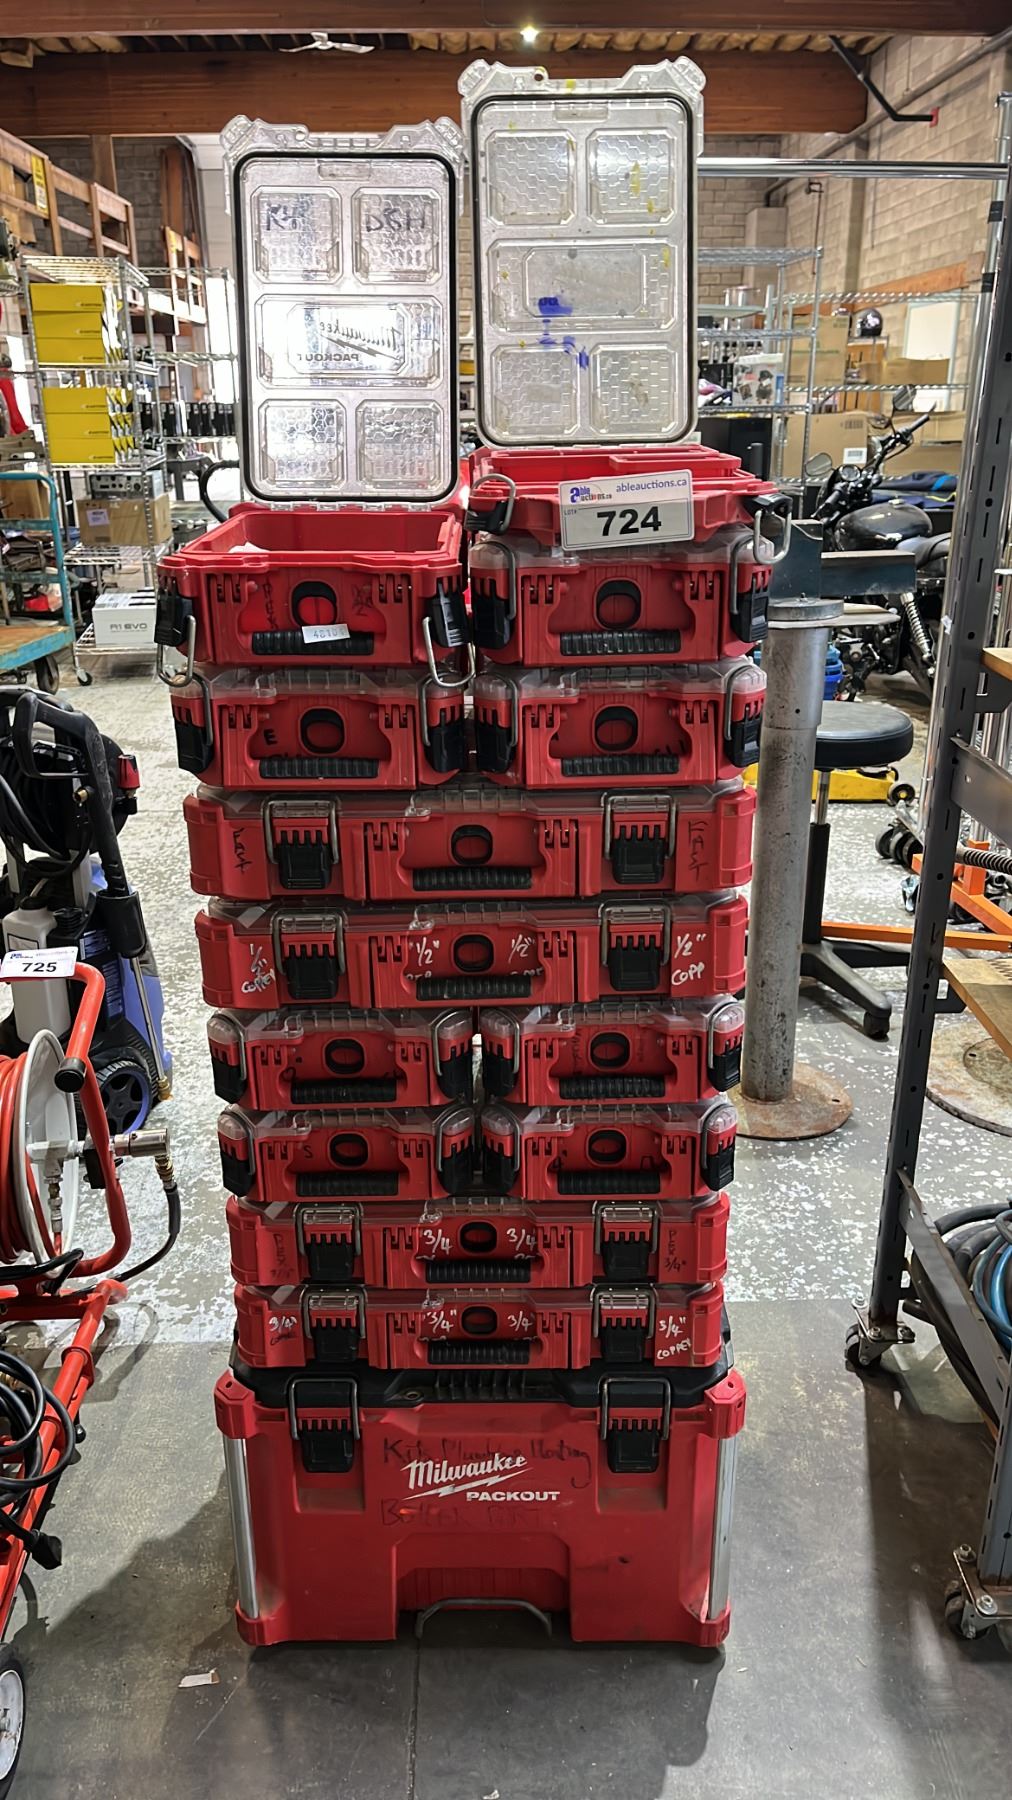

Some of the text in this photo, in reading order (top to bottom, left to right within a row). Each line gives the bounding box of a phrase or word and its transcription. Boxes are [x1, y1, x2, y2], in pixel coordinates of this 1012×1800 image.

[616, 479, 687, 493] ableauctions.ca
[597, 506, 661, 536] 724
[21, 962, 57, 972] 725
[400, 1453, 528, 1490] Milwaukee
[466, 1491, 560, 1502] PACKOUT
